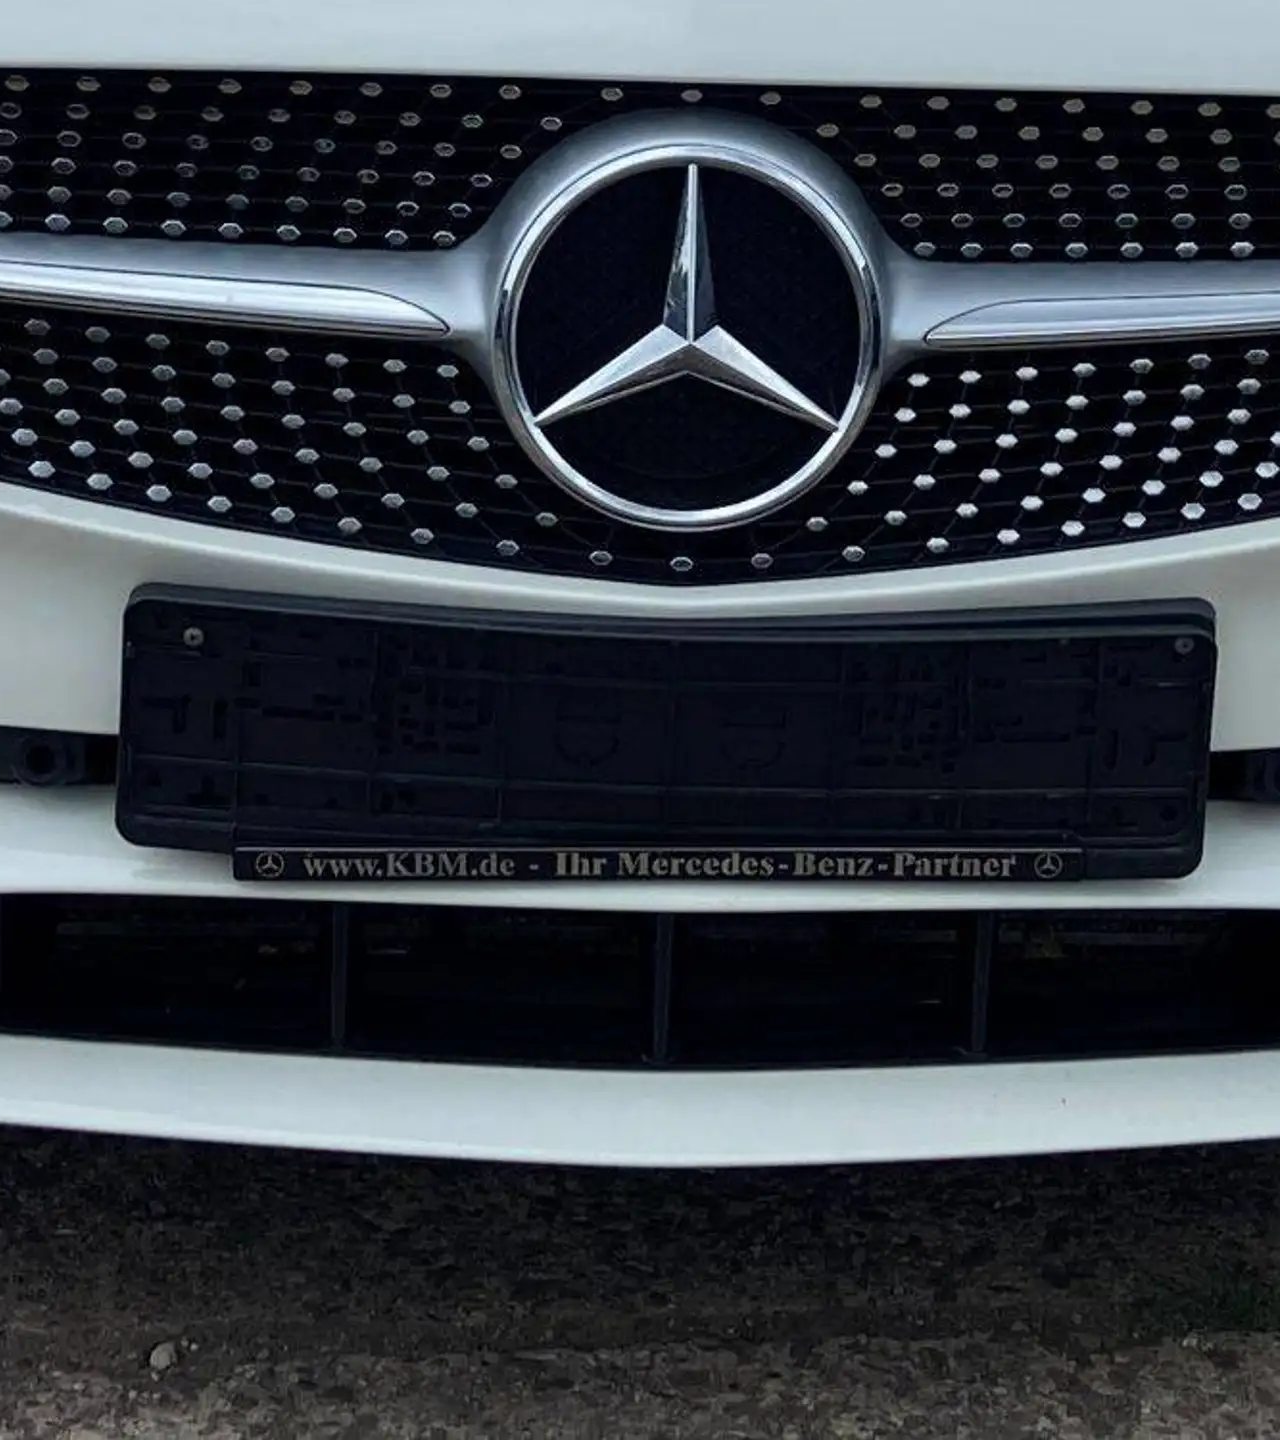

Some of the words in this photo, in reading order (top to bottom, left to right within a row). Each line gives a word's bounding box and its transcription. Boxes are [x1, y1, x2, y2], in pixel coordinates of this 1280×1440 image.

[303, 852, 516, 877] www.KBM.de
[555, 852, 608, 876] Ihr
[618, 852, 1017, 877] Mercedes-Benz-Partner
